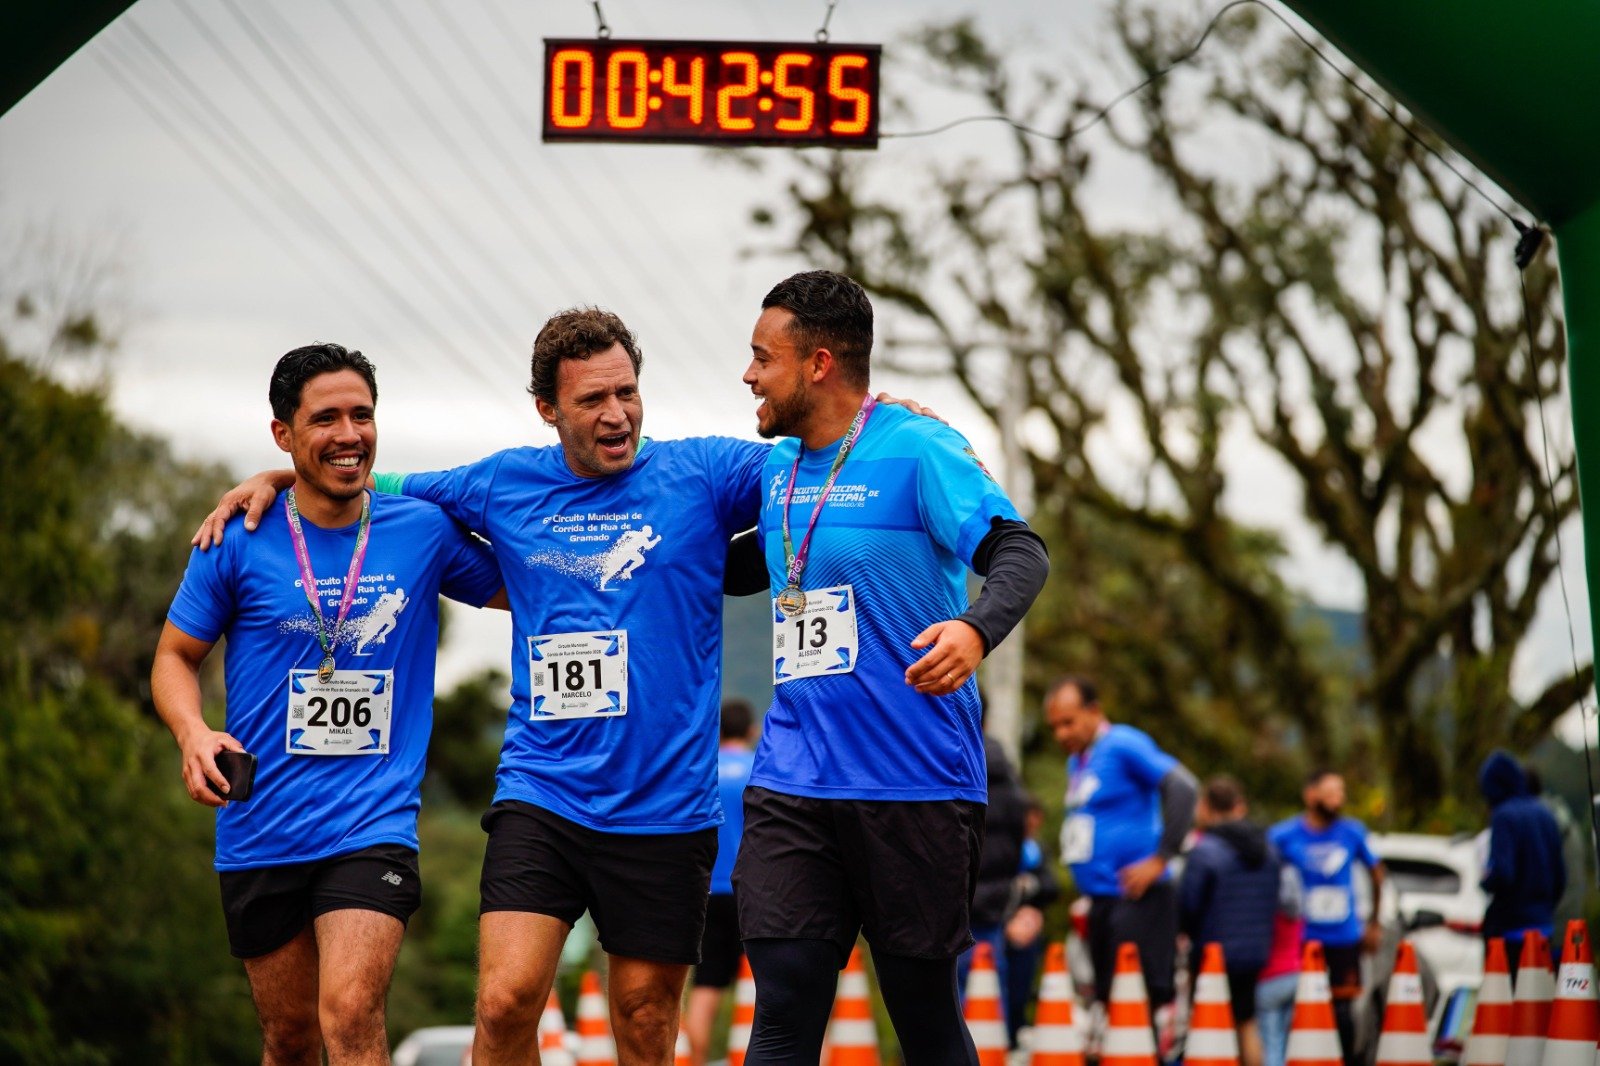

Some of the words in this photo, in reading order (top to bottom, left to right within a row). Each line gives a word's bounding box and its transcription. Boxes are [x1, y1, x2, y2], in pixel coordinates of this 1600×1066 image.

[552, 49, 870, 134] 00:42:55
[776, 495, 811, 504] CORIDA
[552, 514, 584, 522] Circuito
[587, 513, 629, 522] Municipal
[552, 524, 584, 532] Corrida
[570, 534, 610, 542] Gramado
[316, 588, 342, 596] orrida
[358, 585, 375, 594] Rua
[328, 597, 368, 606] Graado
[796, 616, 828, 650] 13
[798, 649, 822, 658] ALISSON
[548, 658, 602, 692] 181
[307, 696, 371, 727] 206
